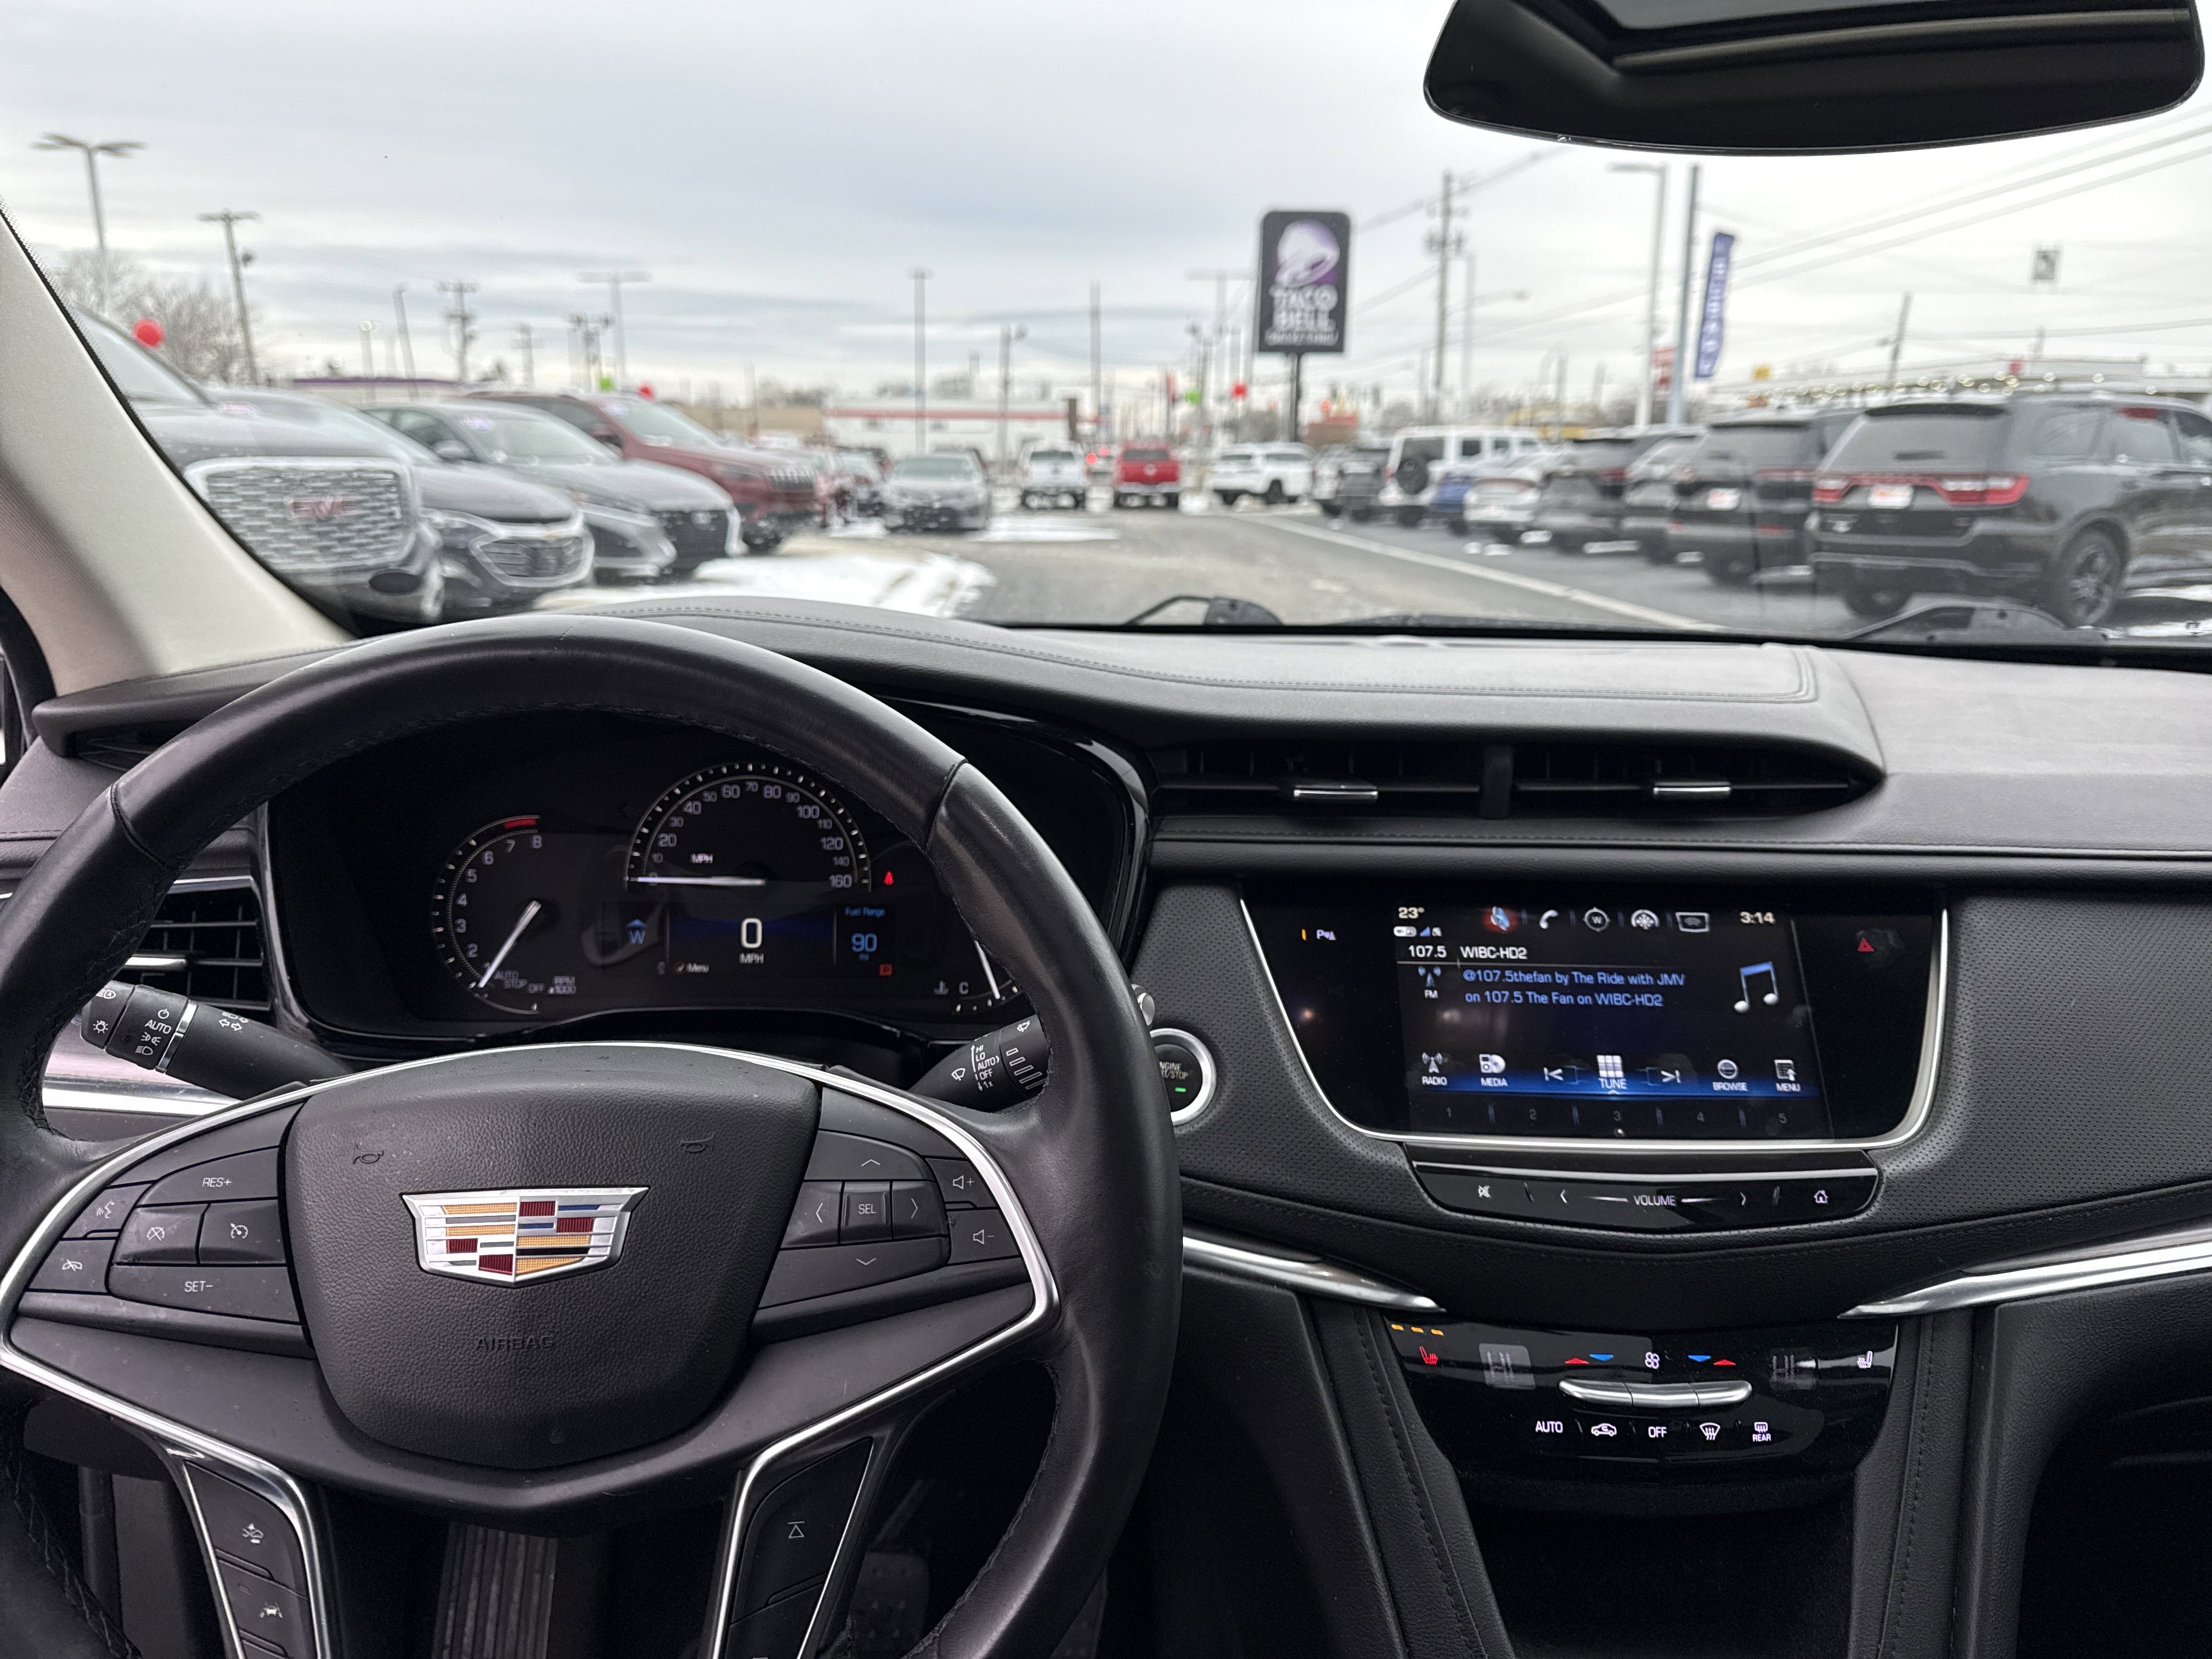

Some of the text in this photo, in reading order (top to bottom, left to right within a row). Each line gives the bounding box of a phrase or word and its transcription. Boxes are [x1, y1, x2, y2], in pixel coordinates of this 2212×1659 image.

[721, 785, 740, 798] 60
[746, 781, 758, 792] 70
[763, 785, 781, 798] 80
[702, 791, 717, 802] 50
[786, 792, 800, 803] 90
[684, 801, 701, 814] 40
[797, 805, 820, 819] 100
[669, 816, 684, 827] 30
[818, 818, 832, 829] 110
[507, 839, 515, 853] 7
[531, 834, 542, 849] 8
[658, 833, 677, 847] 20
[821, 837, 843, 850] 120
[483, 850, 494, 865] 6
[652, 852, 663, 864] 10
[690, 853, 713, 864] MPH
[833, 855, 850, 866] 140
[467, 868, 476, 882] 5
[829, 874, 852, 888] 160
[456, 893, 467, 905] 4
[1740, 911, 1775, 923] 3:14
[455, 918, 466, 933] 3
[629, 930, 646, 944] W
[741, 918, 762, 949] 0
[851, 933, 877, 952] 90
[467, 943, 478, 957] 2
[1409, 945, 1447, 958] 107.5
[1460, 946, 1528, 960] WIBC-HD2
[740, 952, 764, 964] MPH
[686, 962, 709, 973] Menu
[1463, 969, 1685, 986] @107.5thefan by The Ride with JMV
[959, 981, 968, 995] C
[1425, 990, 1438, 998] FM
[1465, 990, 1664, 1007] on 107.5 The Fan on WIBC-HD2
[145, 1019, 172, 1035] AUTO
[975, 1045, 984, 1053] HI
[976, 1052, 985, 1062] LO
[978, 1058, 996, 1070] AUTO
[1160, 1061, 1181, 1070] NGINE
[980, 1069, 993, 1080] OFF
[1422, 1076, 1448, 1086] RADIO
[1481, 1077, 1508, 1087] MEDIA
[1599, 1078, 1627, 1090] TUNE
[1712, 1082, 1747, 1091] BROWSE
[1776, 1084, 1801, 1092] MENU
[1446, 1107, 1452, 1118] 1
[1529, 1109, 1536, 1120] 2
[1613, 1110, 1621, 1121] 3
[1697, 1111, 1704, 1122] 4
[1779, 1113, 1787, 1124] 5
[202, 1177, 232, 1188] RES+
[1633, 1195, 1676, 1206] VOLUME
[859, 1204, 876, 1214] SEL
[476, 1335, 554, 1350] AIRBAG
[1536, 1421, 1563, 1434] AUTO
[1648, 1426, 1667, 1438] OFF
[1752, 1433, 1771, 1442] REAR
